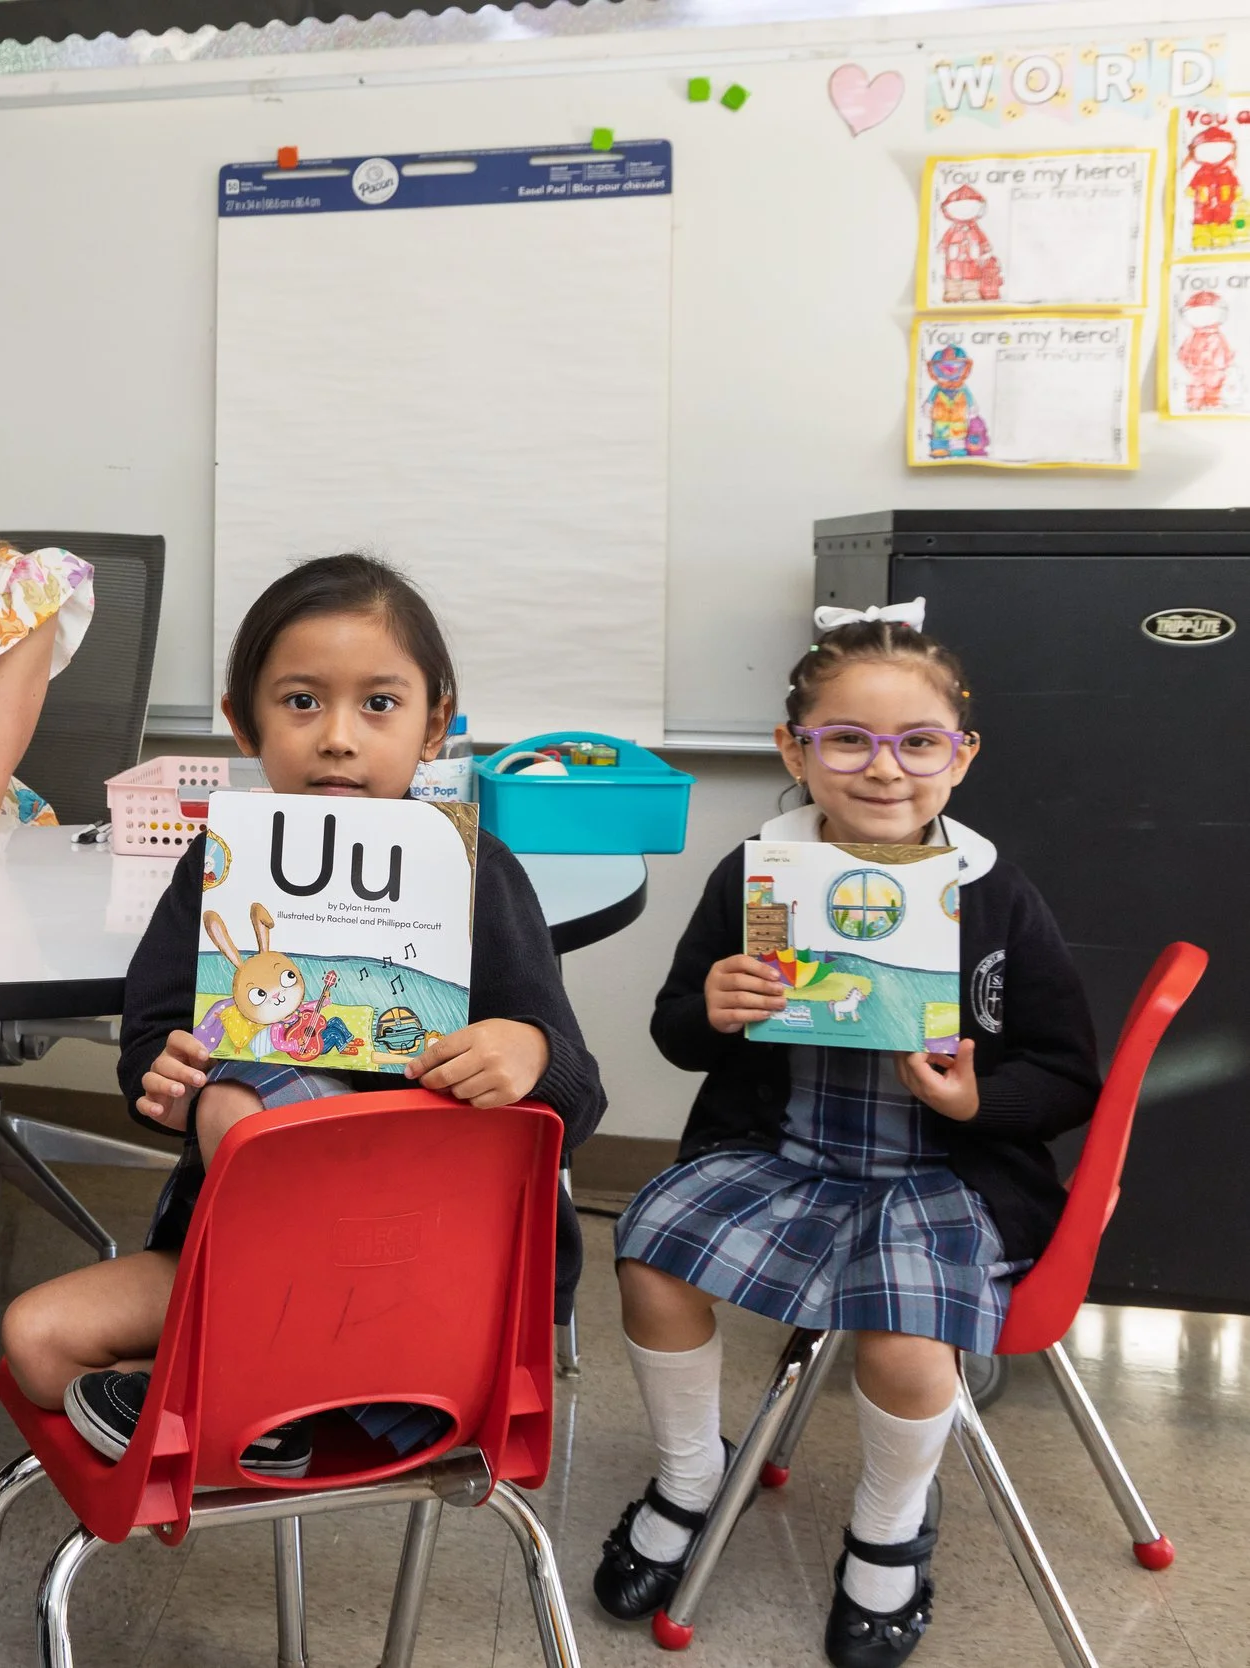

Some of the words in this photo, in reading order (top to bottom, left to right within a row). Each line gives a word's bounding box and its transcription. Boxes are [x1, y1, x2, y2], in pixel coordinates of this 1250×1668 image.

[936, 49, 1215, 111] WORD
[1187, 110, 1228, 126] You
[941, 166, 979, 185] You
[987, 168, 1025, 183] are
[1033, 167, 1068, 189] my
[1075, 162, 1136, 180] hero!
[359, 178, 394, 196] Pacon
[518, 186, 545, 196] Easel
[546, 183, 566, 194] Pad
[572, 182, 594, 193] Bloc
[596, 182, 621, 194] pour
[1176, 274, 1219, 291] You
[926, 328, 964, 345] You
[971, 330, 1011, 345] are
[1018, 330, 1051, 350] my
[1060, 327, 1120, 343] hero!
[410, 786, 430, 796] BC
[433, 787, 457, 797] Pops
[270, 810, 402, 902] Uu
[327, 902, 338, 911] by
[339, 903, 362, 913] Dylan
[363, 905, 391, 914] Hamm
[277, 911, 314, 921] illustrated
[316, 914, 326, 923] by
[327, 915, 358, 924] Rachael
[359, 918, 376, 926] and
[377, 918, 411, 929] Phillippa
[412, 921, 442, 930] Corcutt
